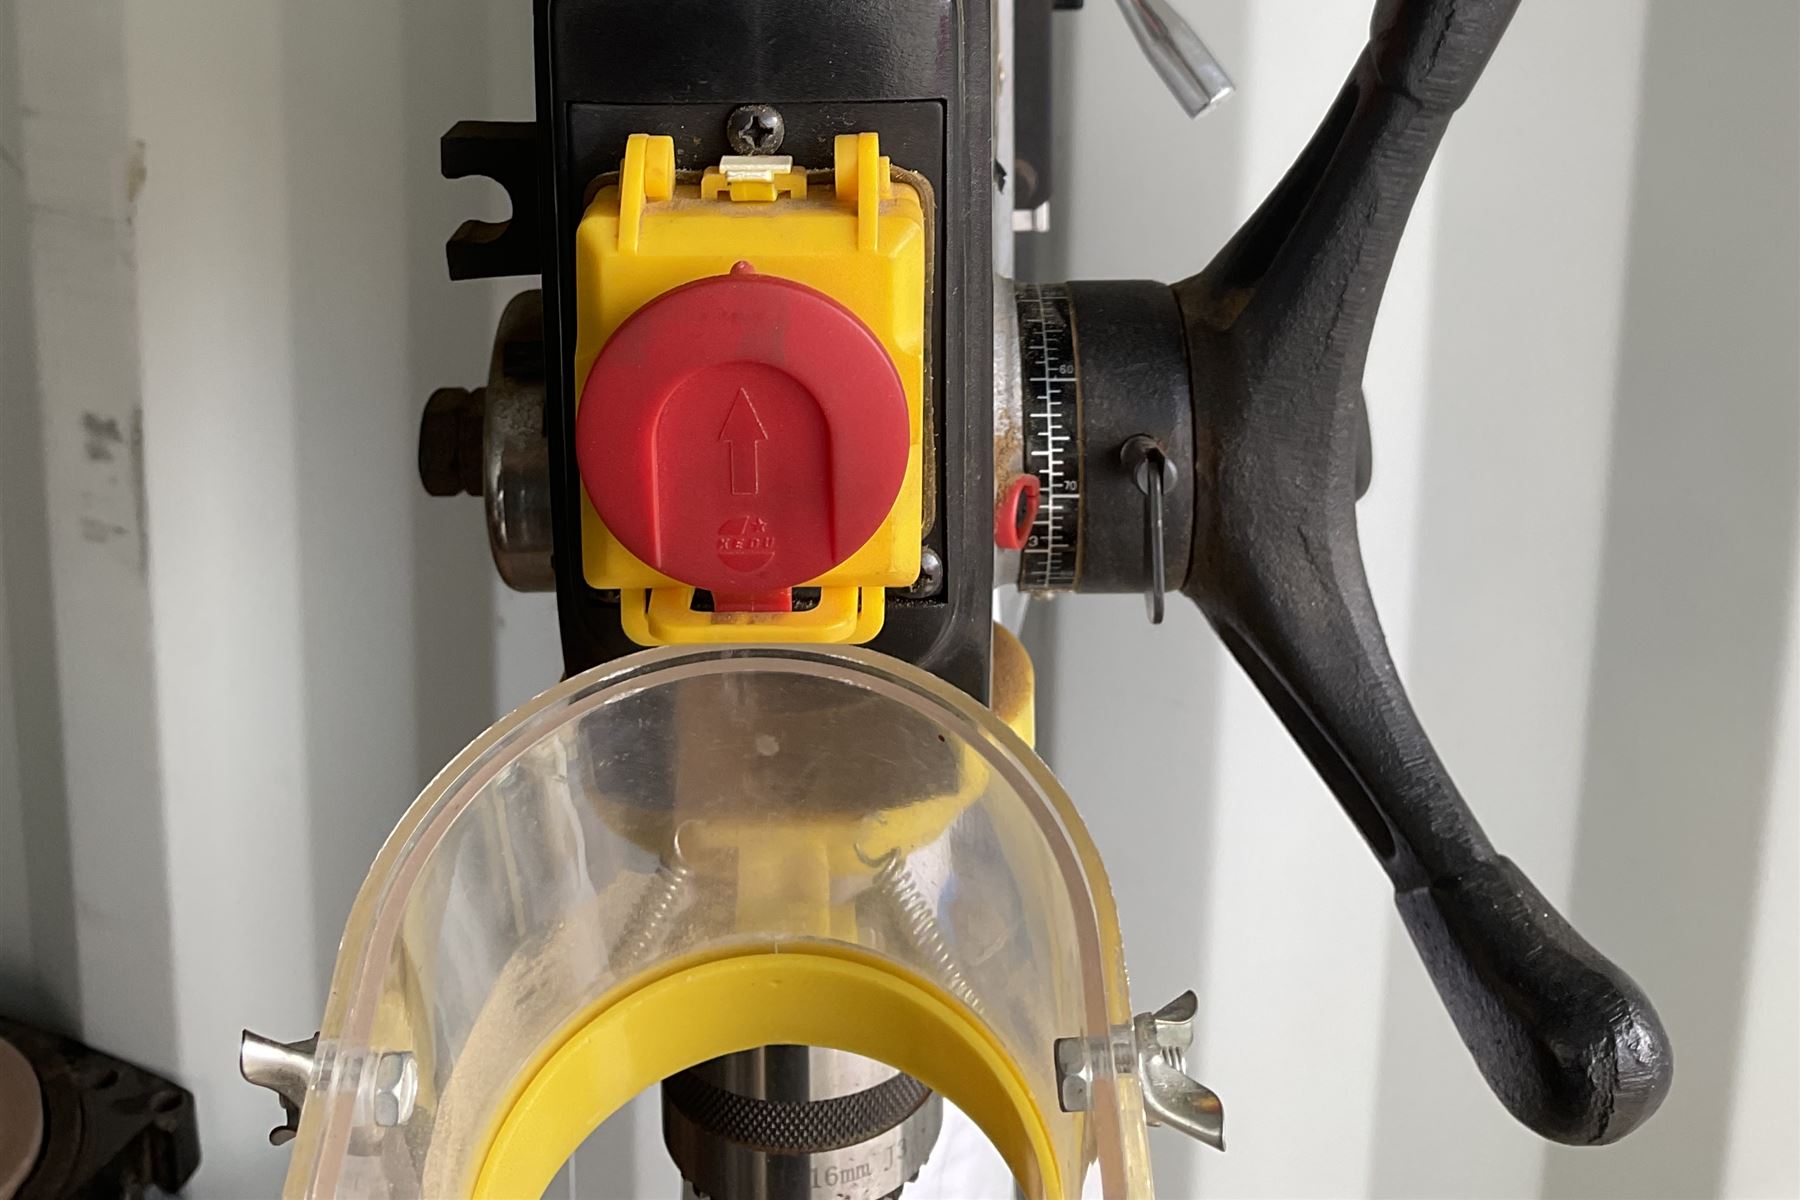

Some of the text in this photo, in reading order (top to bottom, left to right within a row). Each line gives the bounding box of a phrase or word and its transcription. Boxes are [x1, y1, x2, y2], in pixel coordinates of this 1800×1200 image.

[1058, 364, 1075, 375] 60
[1063, 480, 1078, 491] 70
[811, 1163, 872, 1190] 16mm
